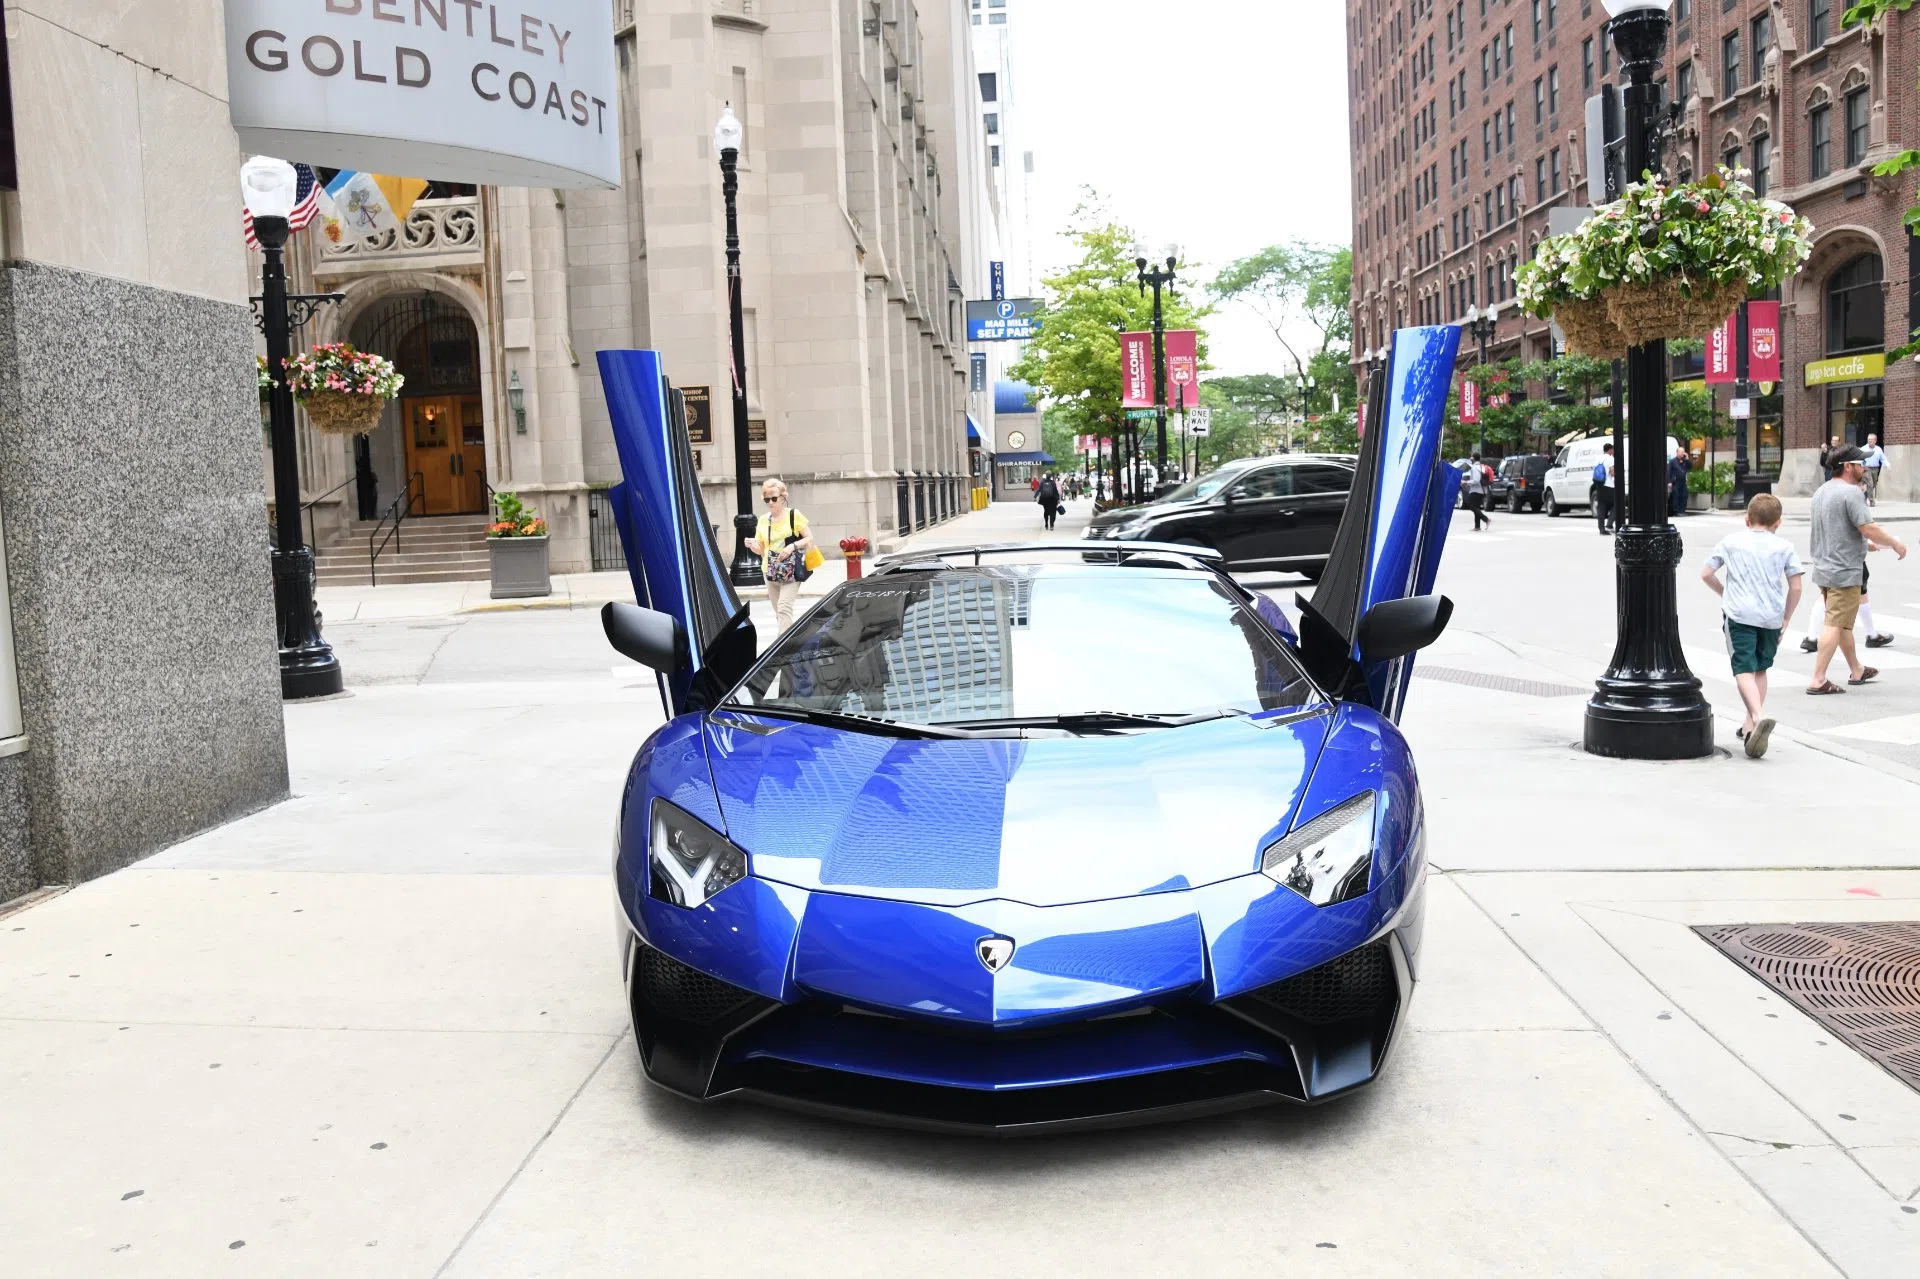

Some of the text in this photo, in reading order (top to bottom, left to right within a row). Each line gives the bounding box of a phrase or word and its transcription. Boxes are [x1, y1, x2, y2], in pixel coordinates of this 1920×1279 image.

[245, 29, 607, 135] GOLD COAST
[1001, 303, 1012, 316] P
[984, 318, 1029, 328] MAG MILE
[977, 328, 1005, 339] SELF
[1128, 341, 1141, 400] WELCOME
[1838, 356, 1865, 376] café
[1191, 410, 1207, 418] ONE
